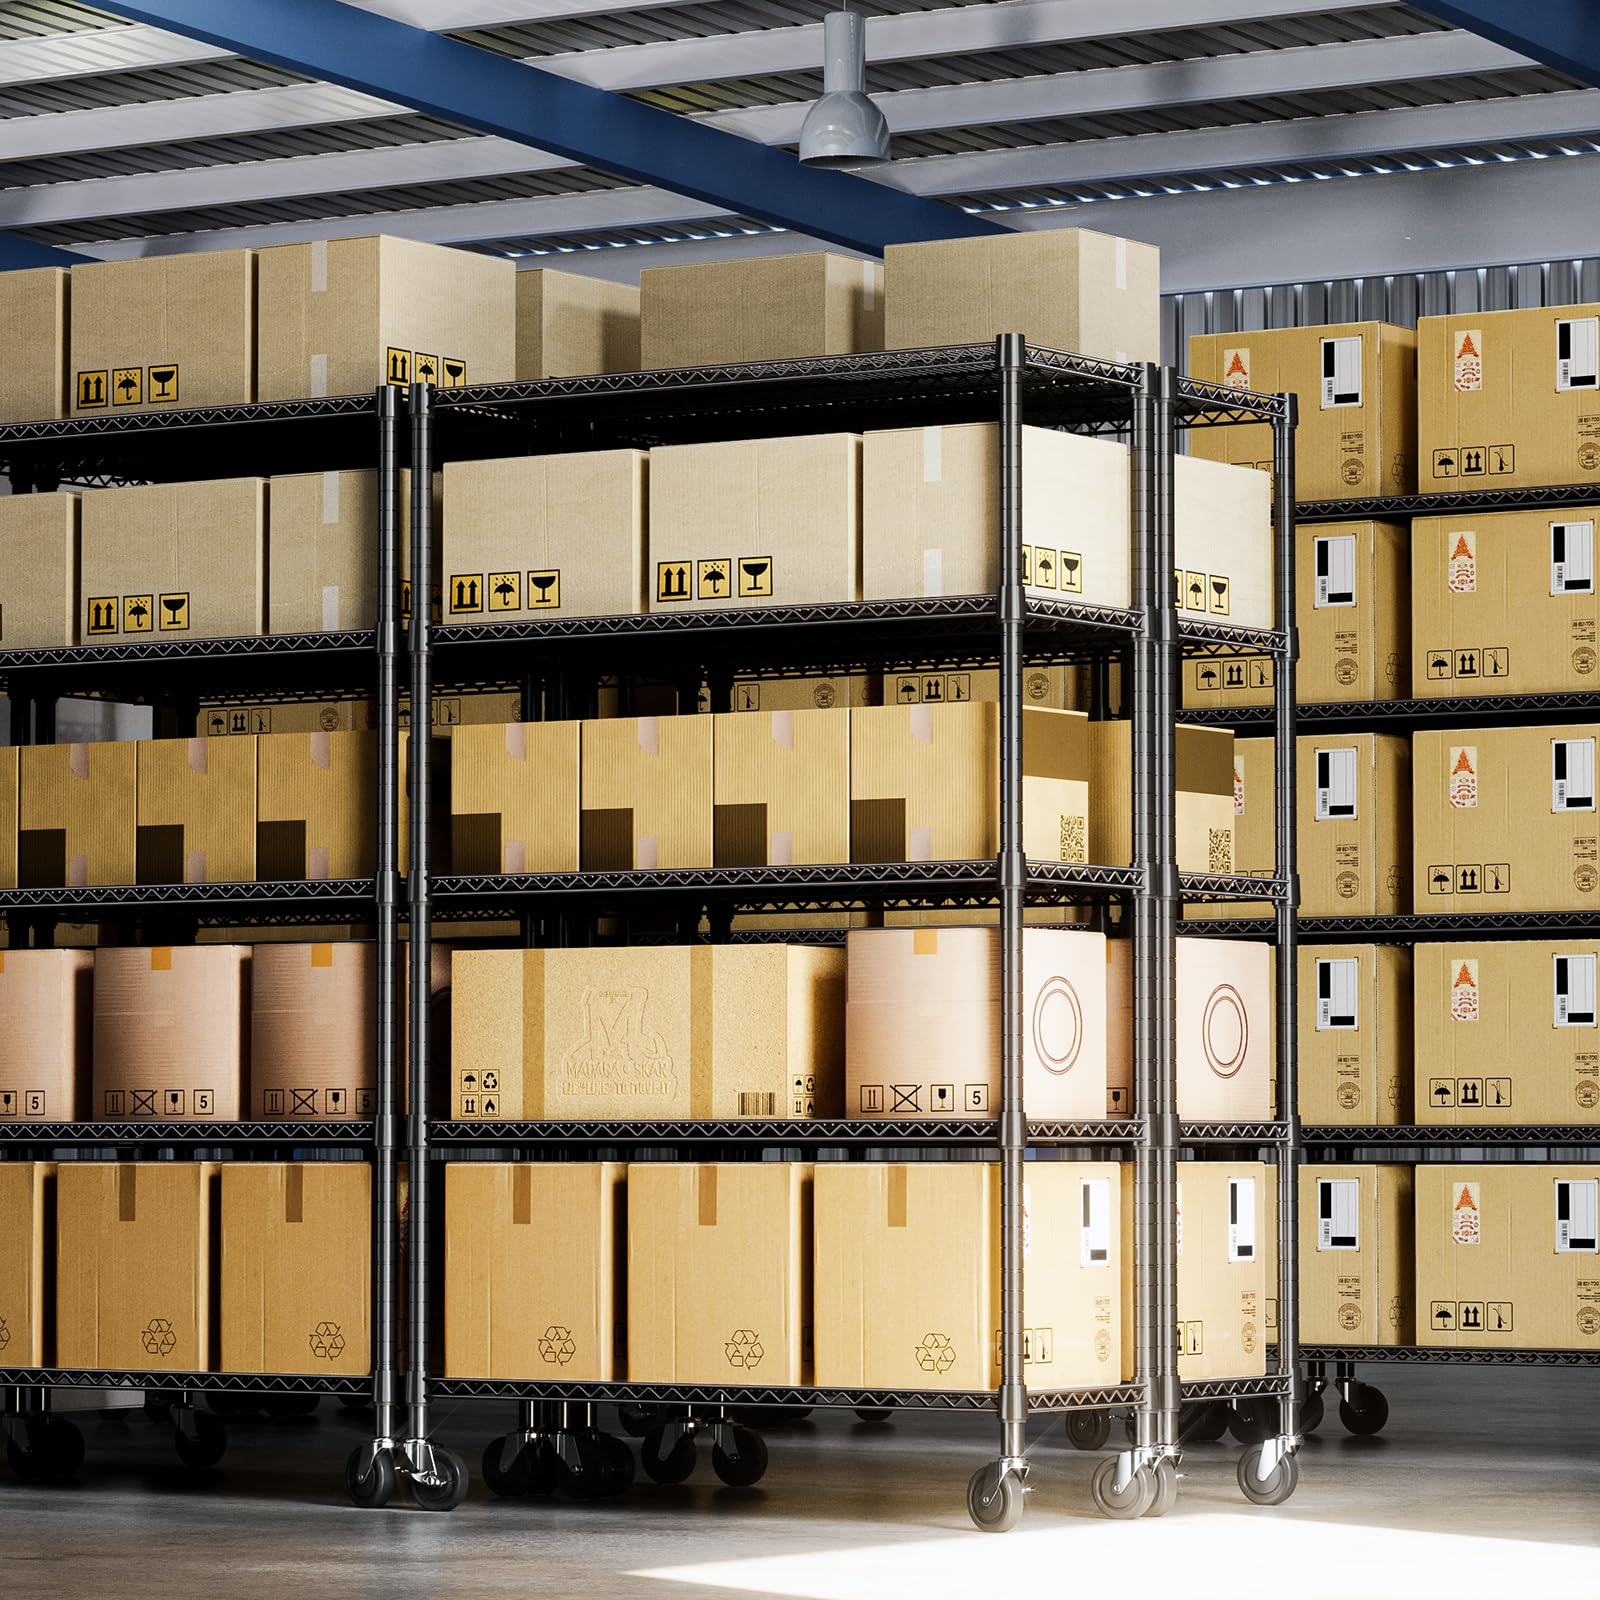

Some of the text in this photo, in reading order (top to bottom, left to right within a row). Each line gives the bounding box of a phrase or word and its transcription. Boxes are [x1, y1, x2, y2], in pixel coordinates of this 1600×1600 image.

[31, 1096, 40, 1110] 5
[199, 1095, 208, 1109] 5
[362, 1094, 370, 1108] 5
[972, 1090, 981, 1105] 5
